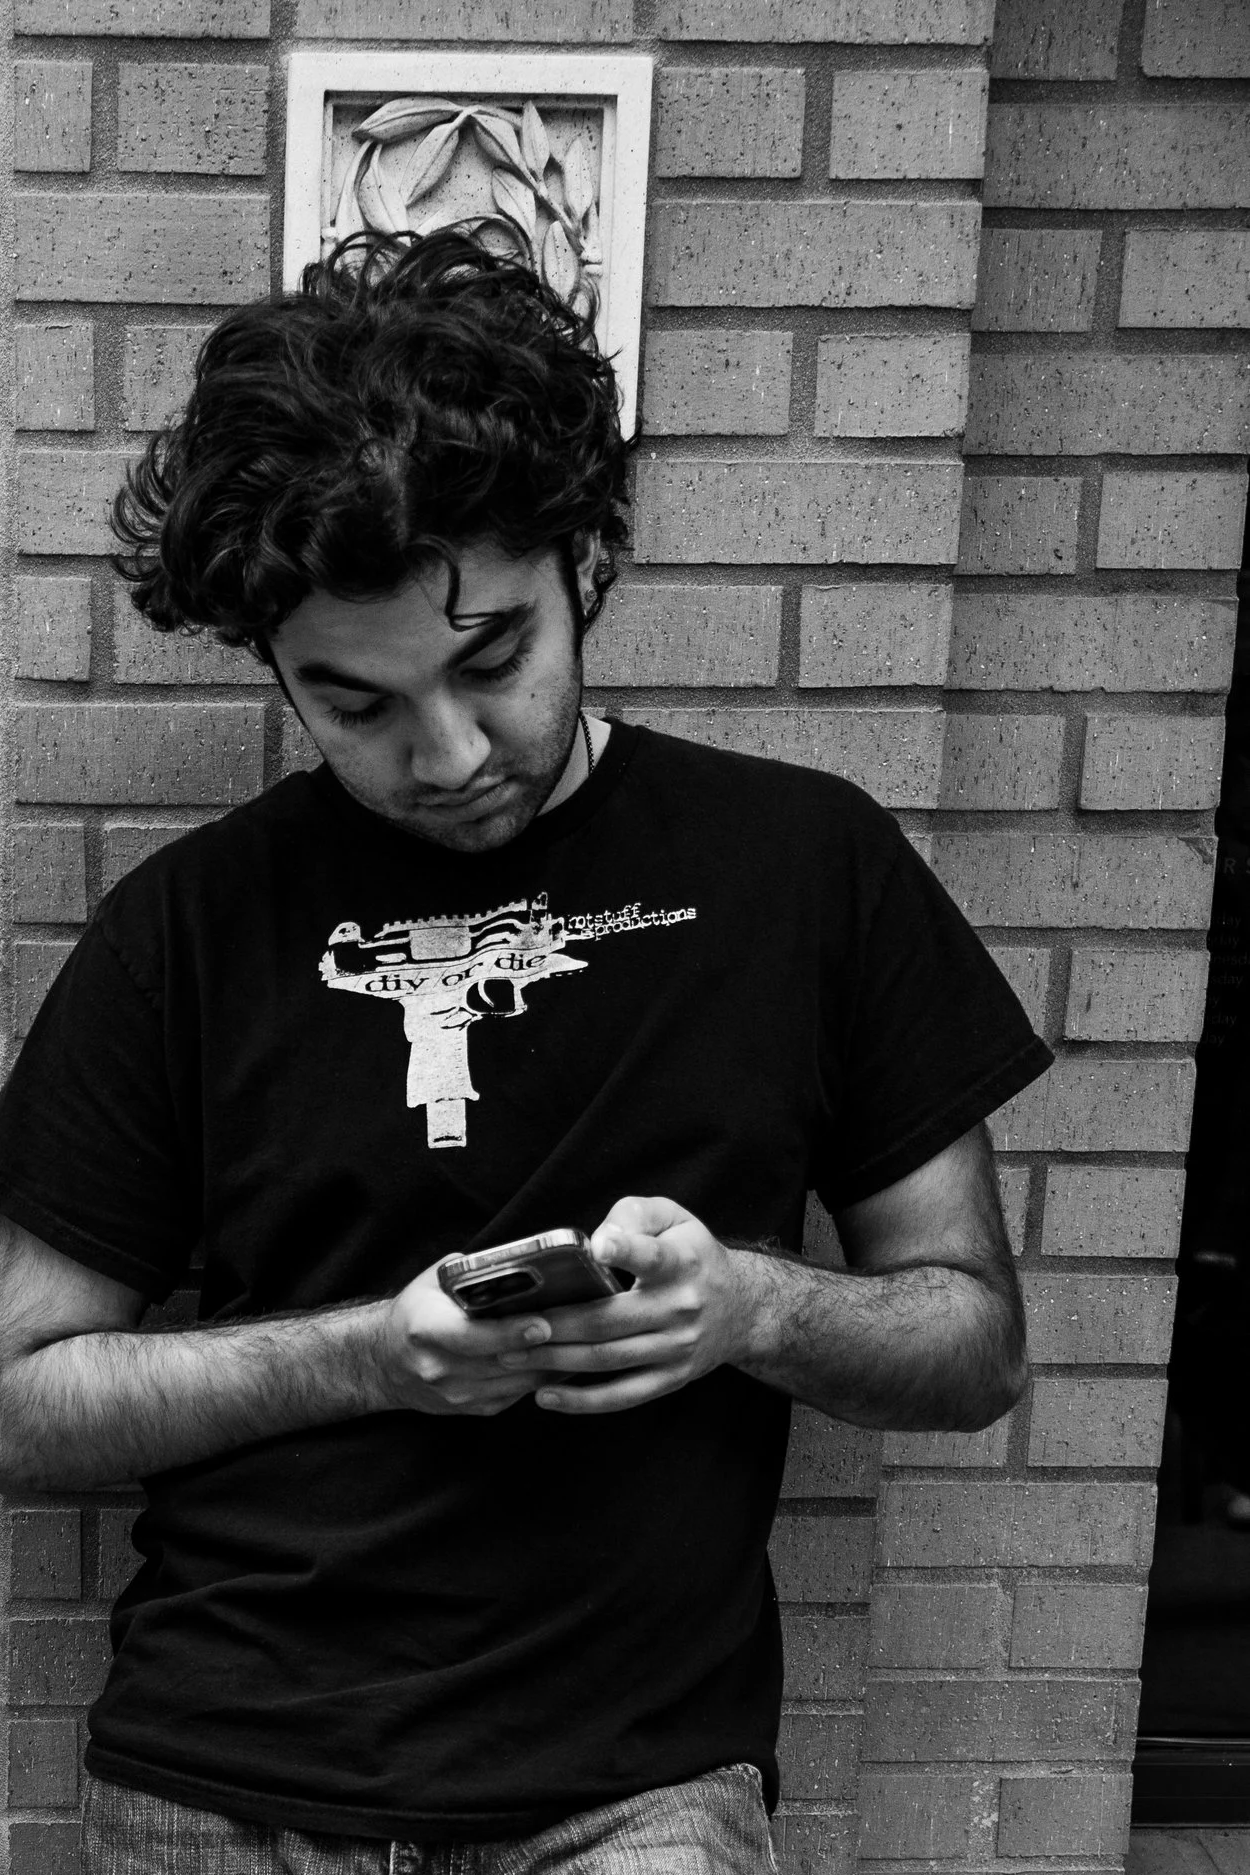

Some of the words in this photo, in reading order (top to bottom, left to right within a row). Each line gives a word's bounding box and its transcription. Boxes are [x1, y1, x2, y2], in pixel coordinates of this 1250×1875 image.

[594, 908, 696, 941] productions
[365, 974, 429, 994] diy
[442, 962, 483, 986] or
[494, 953, 547, 971] die
